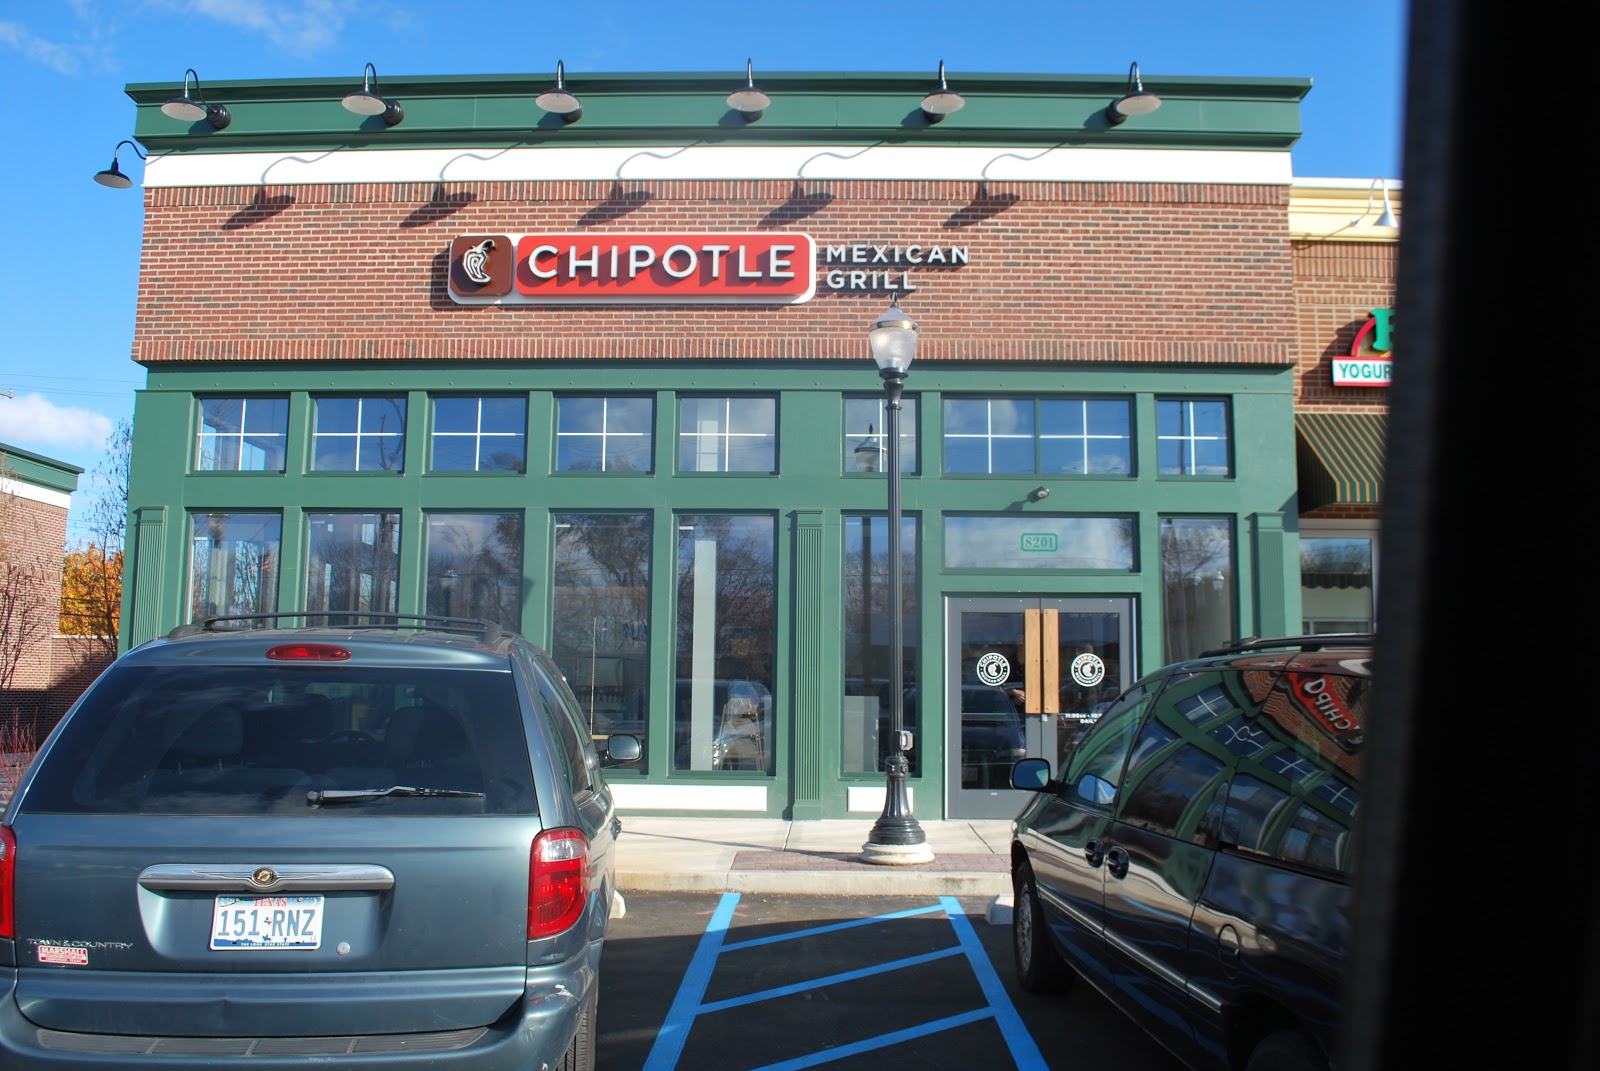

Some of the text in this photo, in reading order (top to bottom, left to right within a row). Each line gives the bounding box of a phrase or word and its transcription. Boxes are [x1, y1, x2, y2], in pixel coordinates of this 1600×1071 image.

[826, 244, 970, 265] MEXICAN
[528, 244, 796, 279] CHIPOTLE
[826, 270, 917, 290] GRILL
[1025, 536, 1054, 549] 8201
[979, 655, 1007, 668] CHIPOTLE
[1074, 655, 1102, 668] CHIPOTLE
[254, 897, 288, 907] TEXAS
[217, 909, 316, 937] 151 RNZ
[27, 938, 61, 946] TOWN
[71, 940, 133, 949] COUNTRY
[41, 947, 86, 956] MARSHALL
